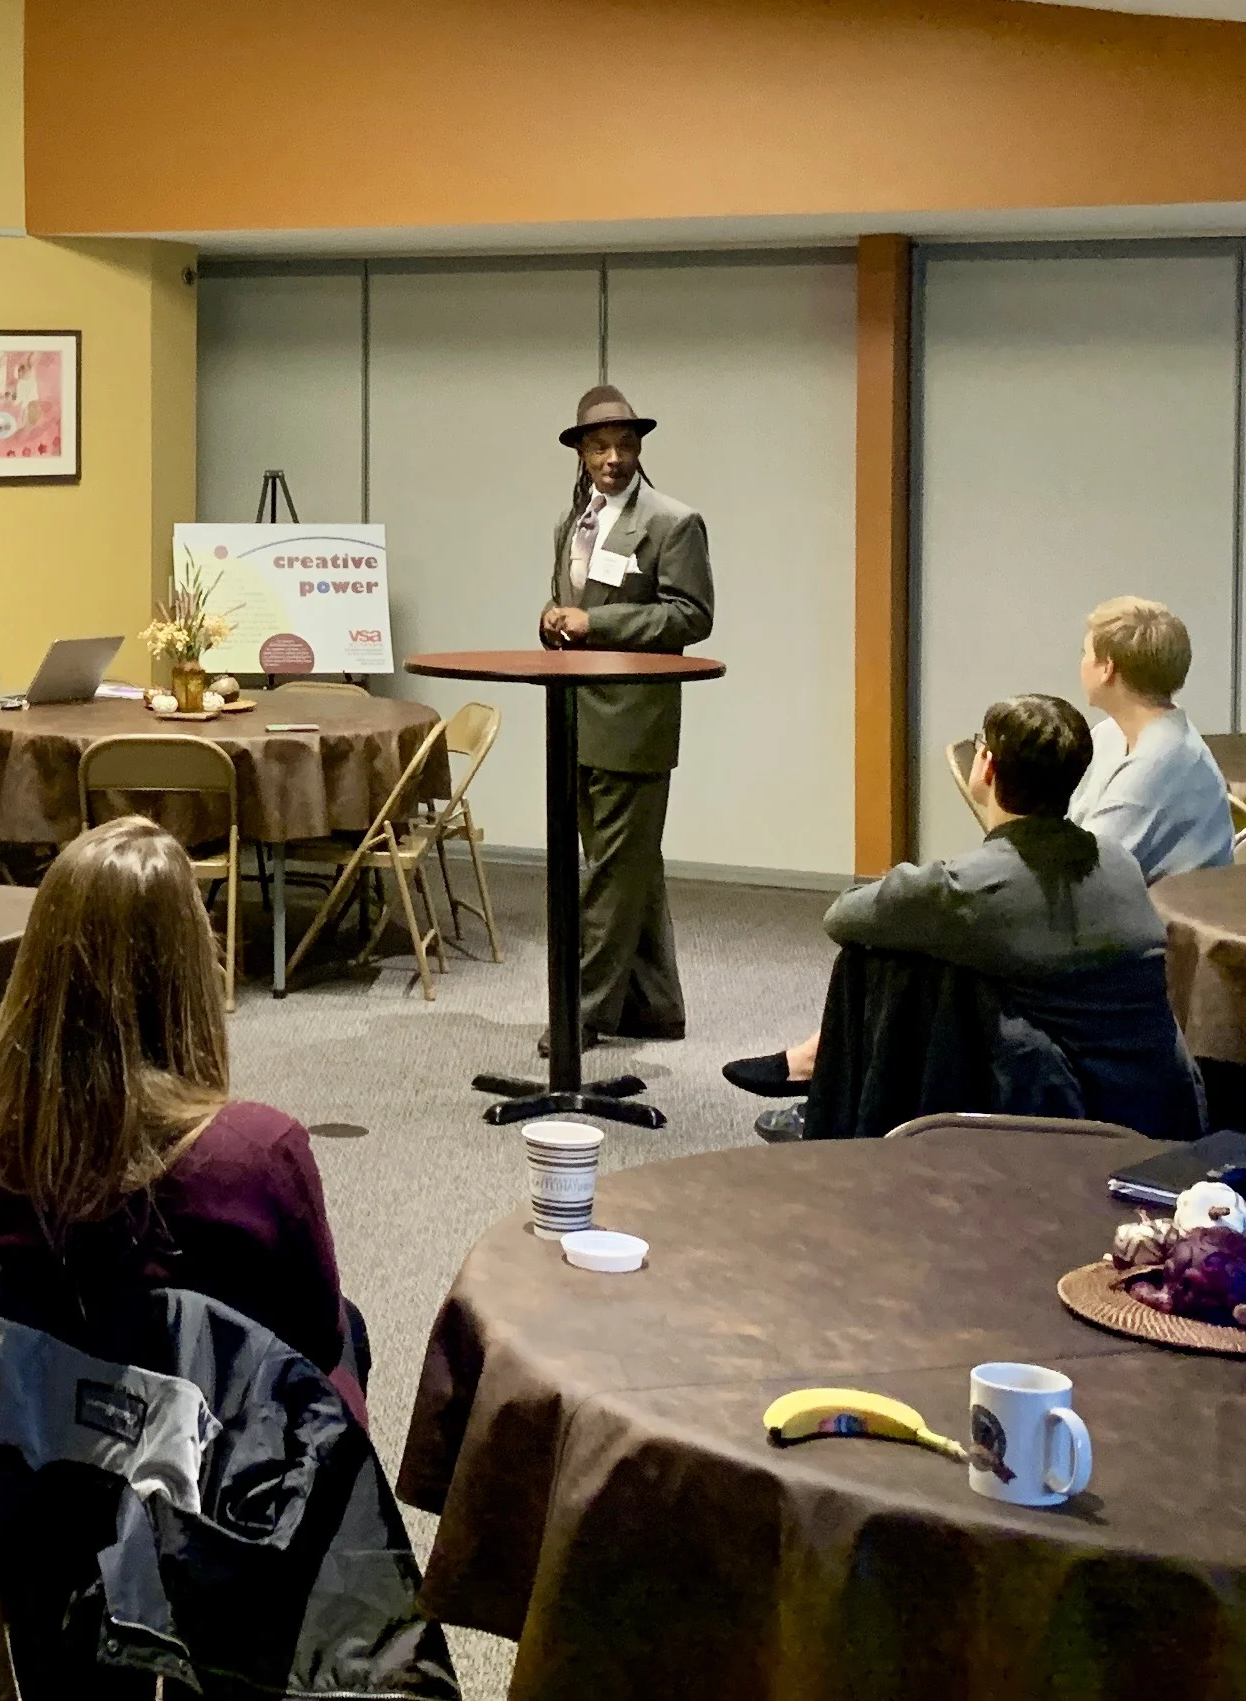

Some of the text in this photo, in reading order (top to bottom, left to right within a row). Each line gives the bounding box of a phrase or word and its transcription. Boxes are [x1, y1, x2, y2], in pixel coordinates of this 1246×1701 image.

[273, 553, 378, 569] creative
[299, 581, 379, 597] power
[348, 629, 382, 642] vsa
